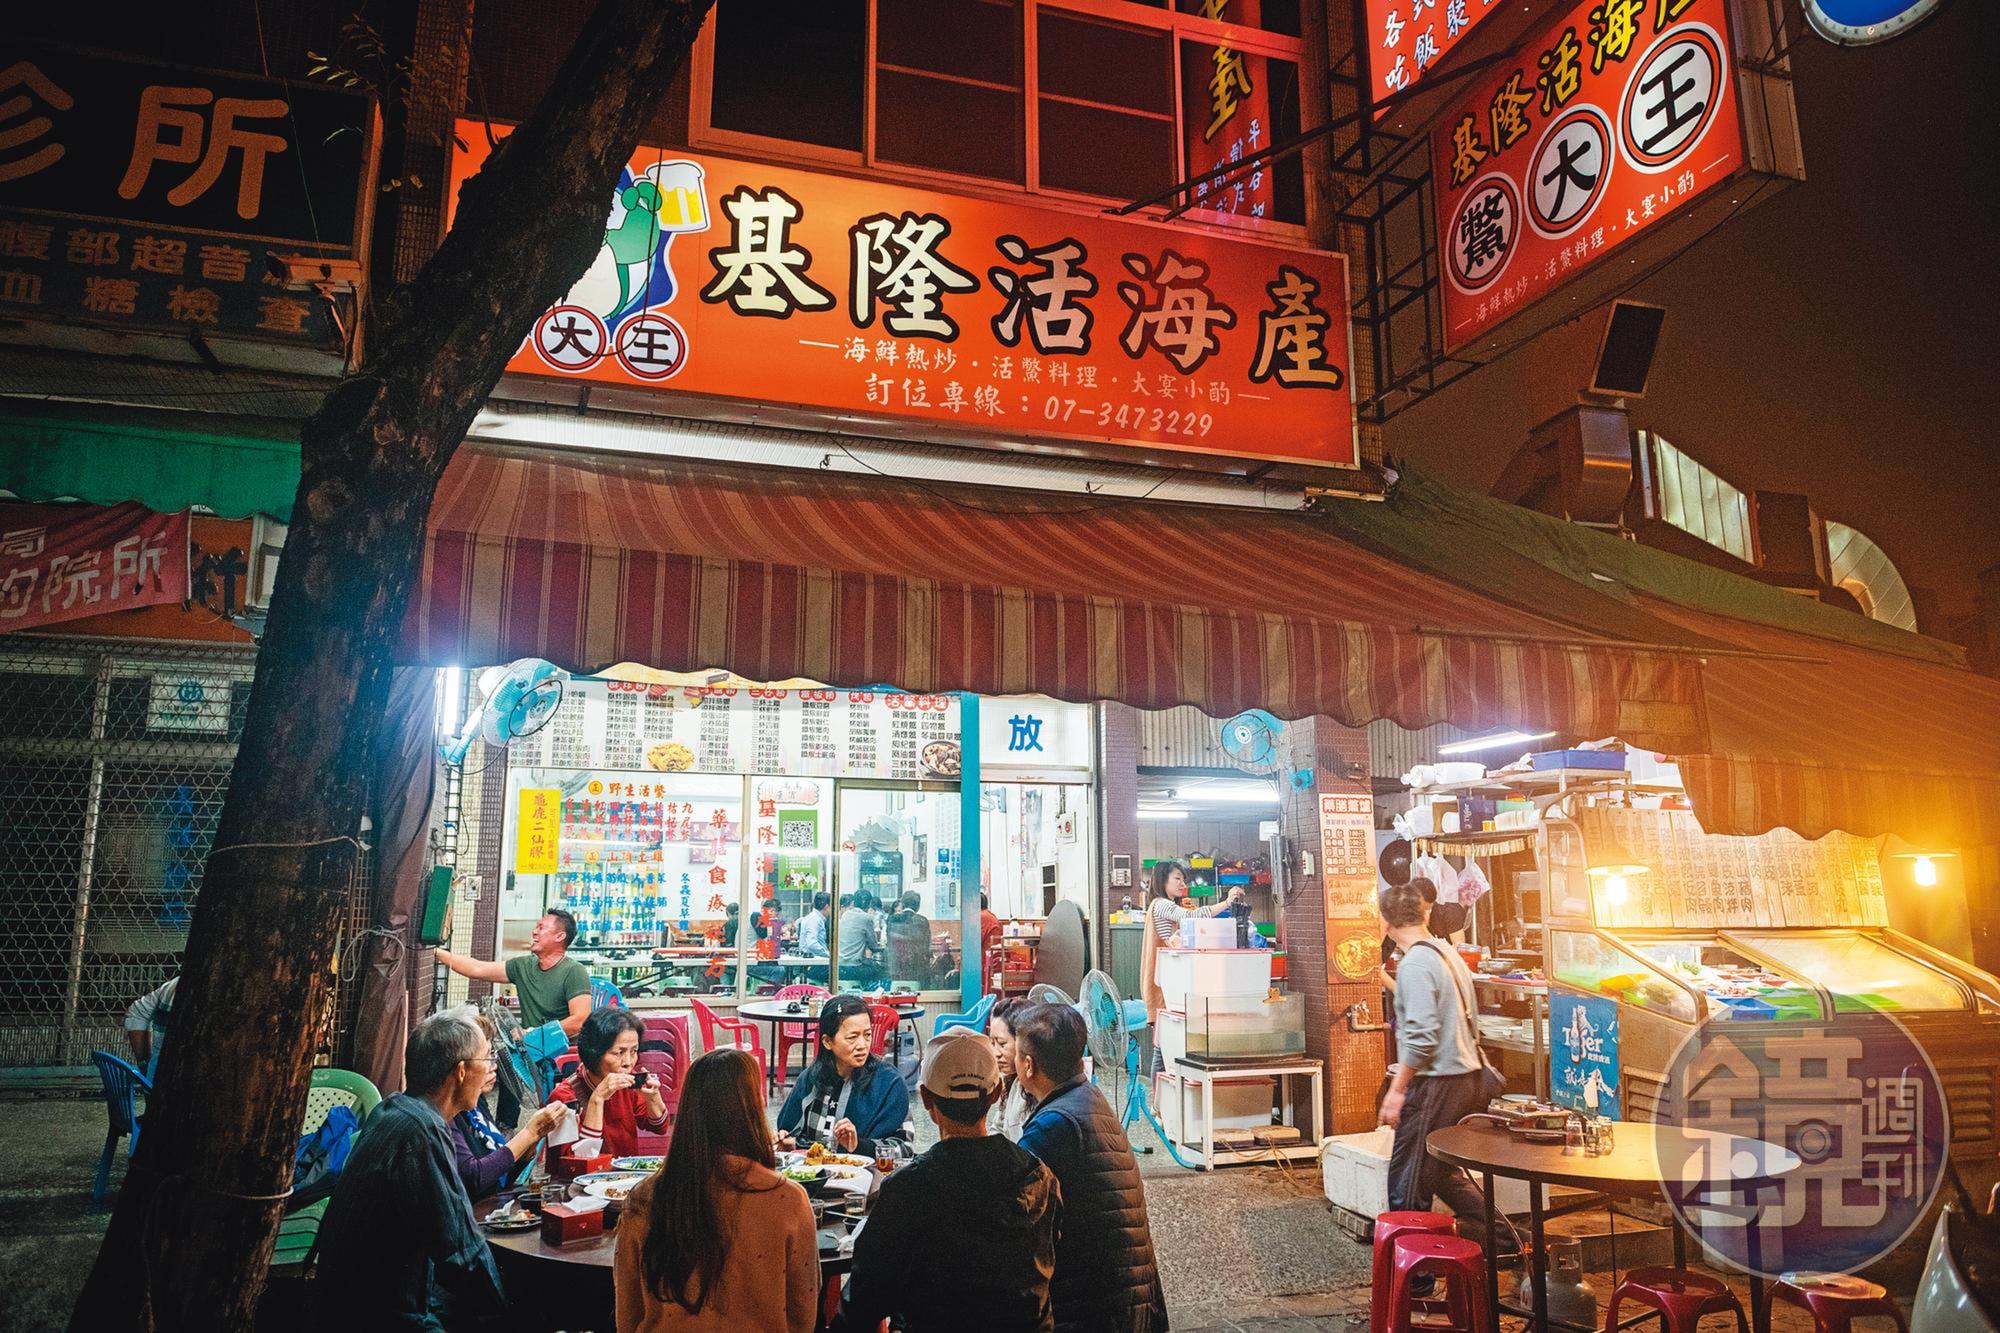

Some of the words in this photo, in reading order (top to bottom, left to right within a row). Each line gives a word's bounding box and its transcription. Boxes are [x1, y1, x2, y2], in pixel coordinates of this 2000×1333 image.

[1385, 0, 1492, 90] 吃飯聚
[1451, 0, 1690, 186] 基隆活海
[0, 221, 279, 283] 腹部超音
[709, 187, 1342, 388] 基隆活海產
[1043, 395, 1213, 439] 07-3473229
[1008, 714, 1043, 752] 放
[1562, 1027, 1603, 1058] Tger
